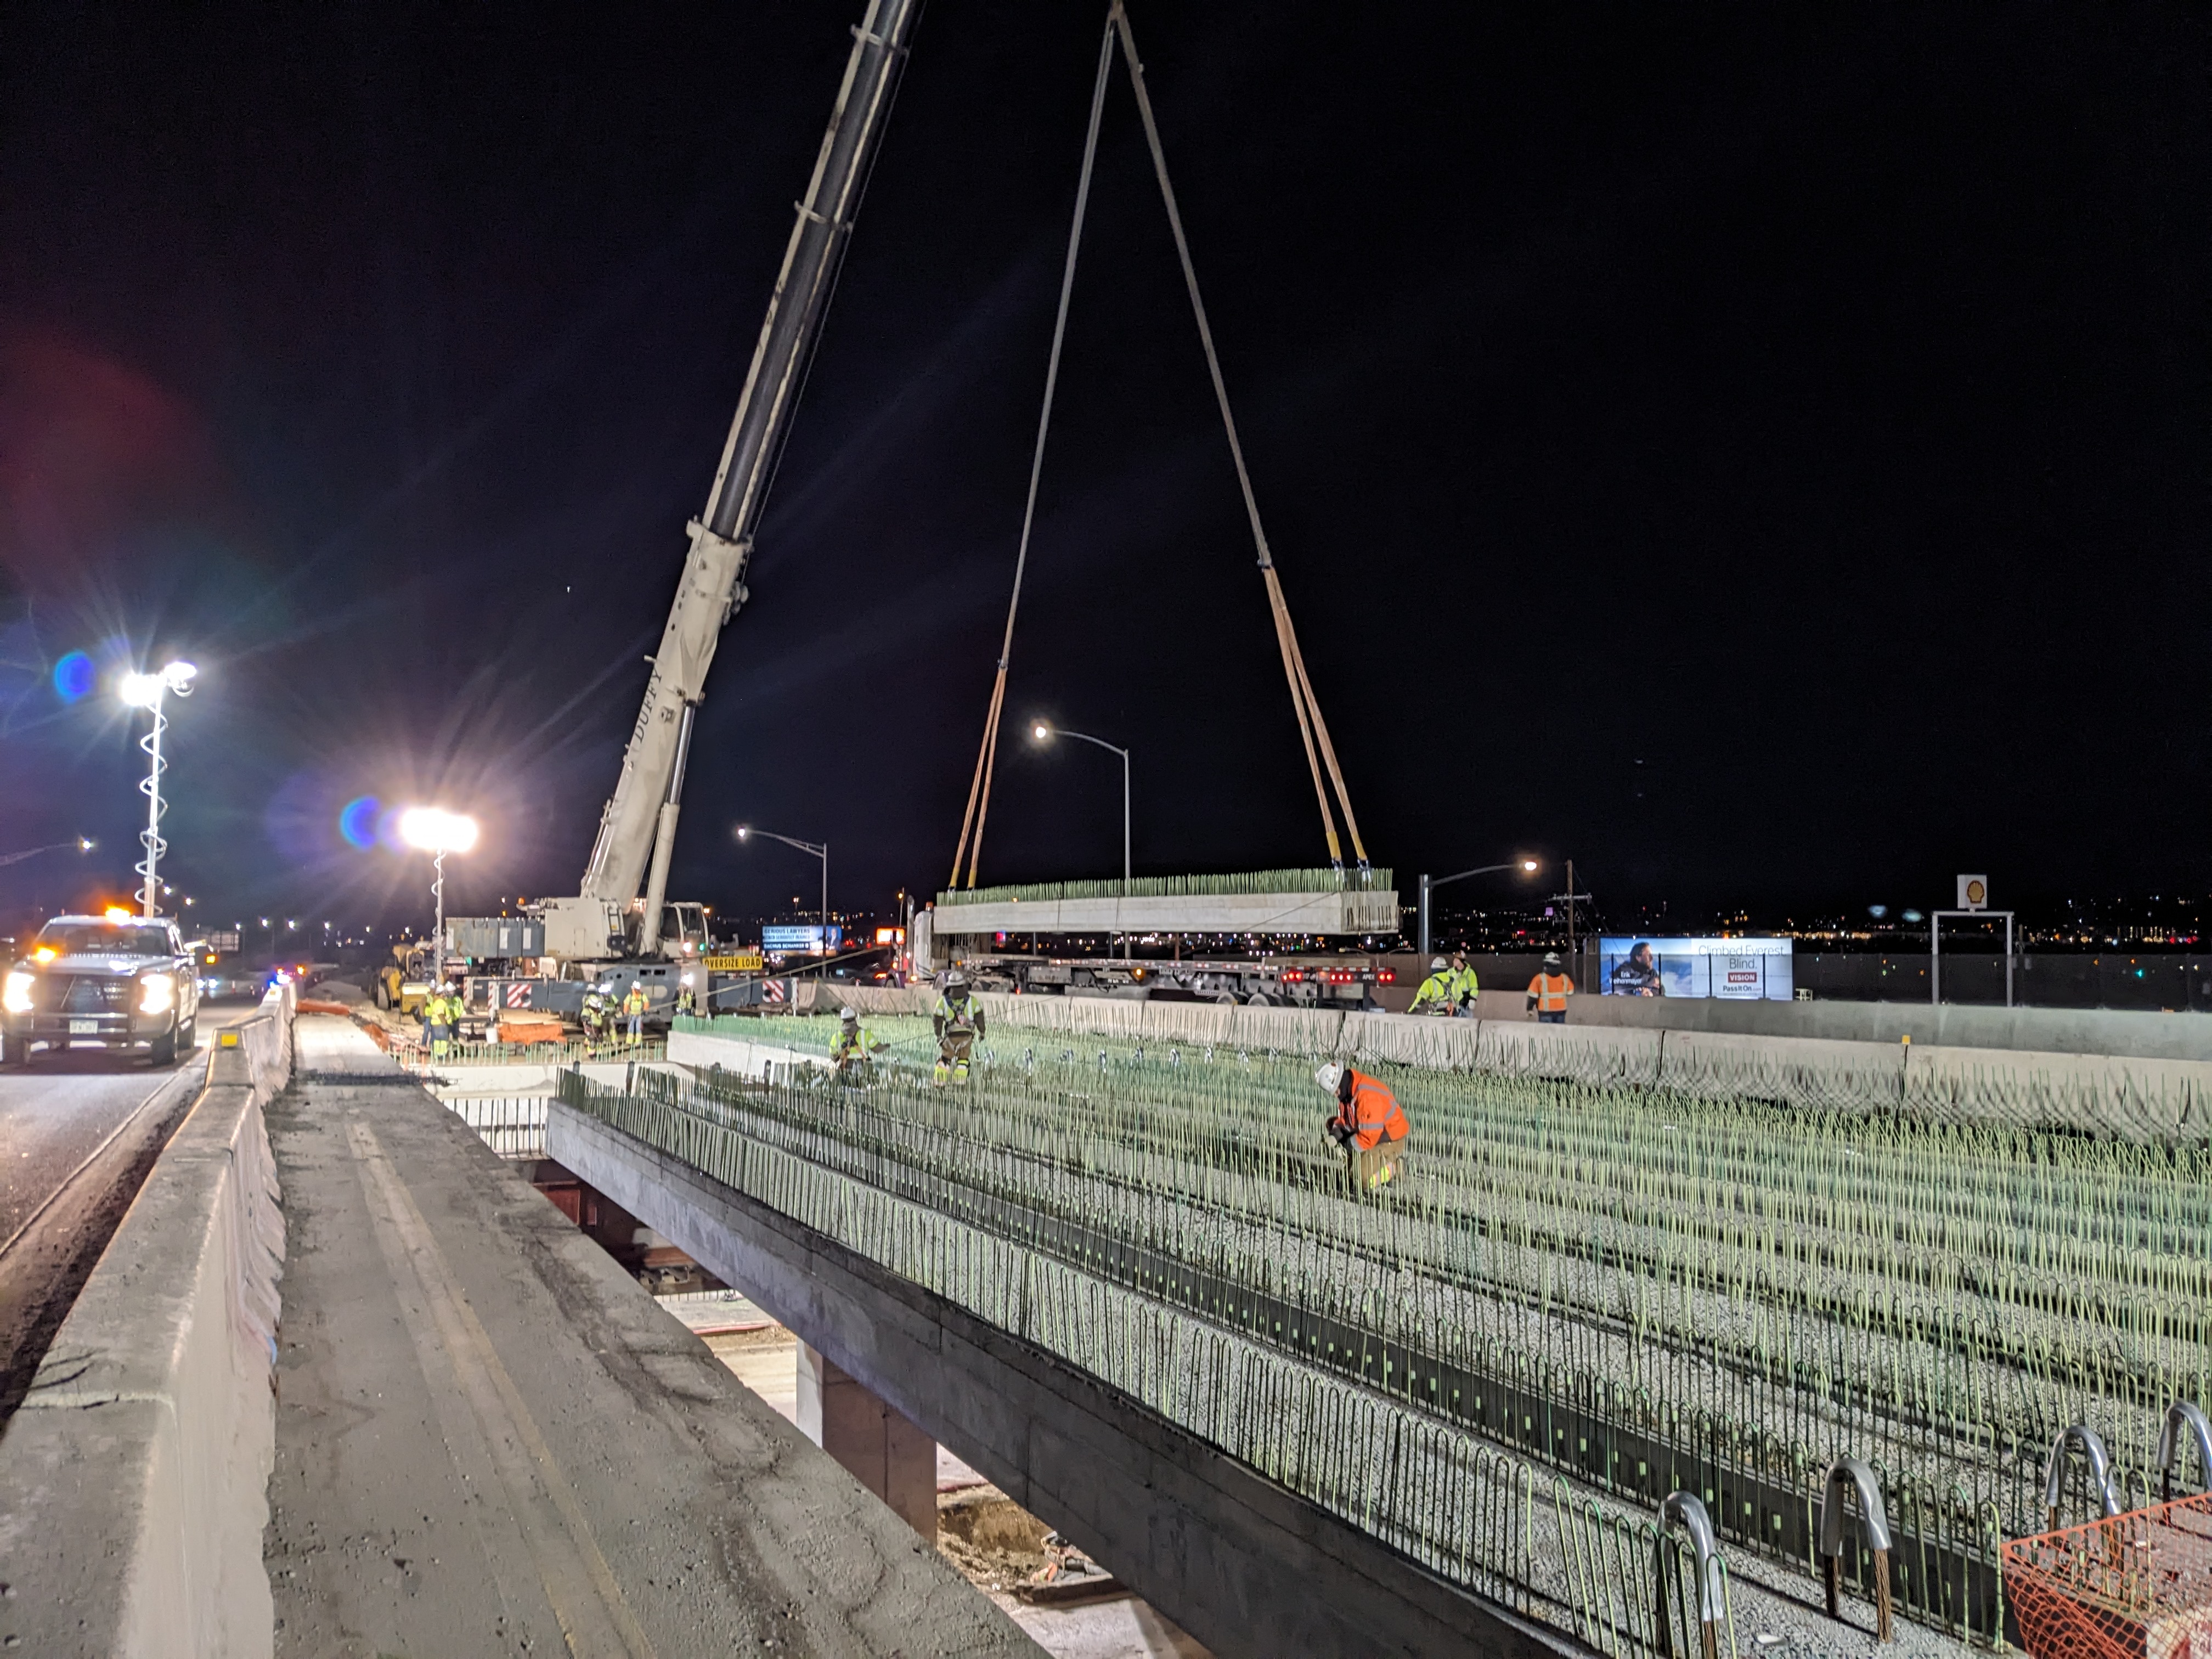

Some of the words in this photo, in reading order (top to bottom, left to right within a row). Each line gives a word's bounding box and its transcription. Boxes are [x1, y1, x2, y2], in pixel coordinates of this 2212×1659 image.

[634, 666, 662, 744] DUFFY
[1699, 945, 1742, 957] Climbed
[704, 959, 739, 968] OVERSIZE
[742, 958, 760, 967] LOAD
[1729, 958, 1757, 969] Blind.
